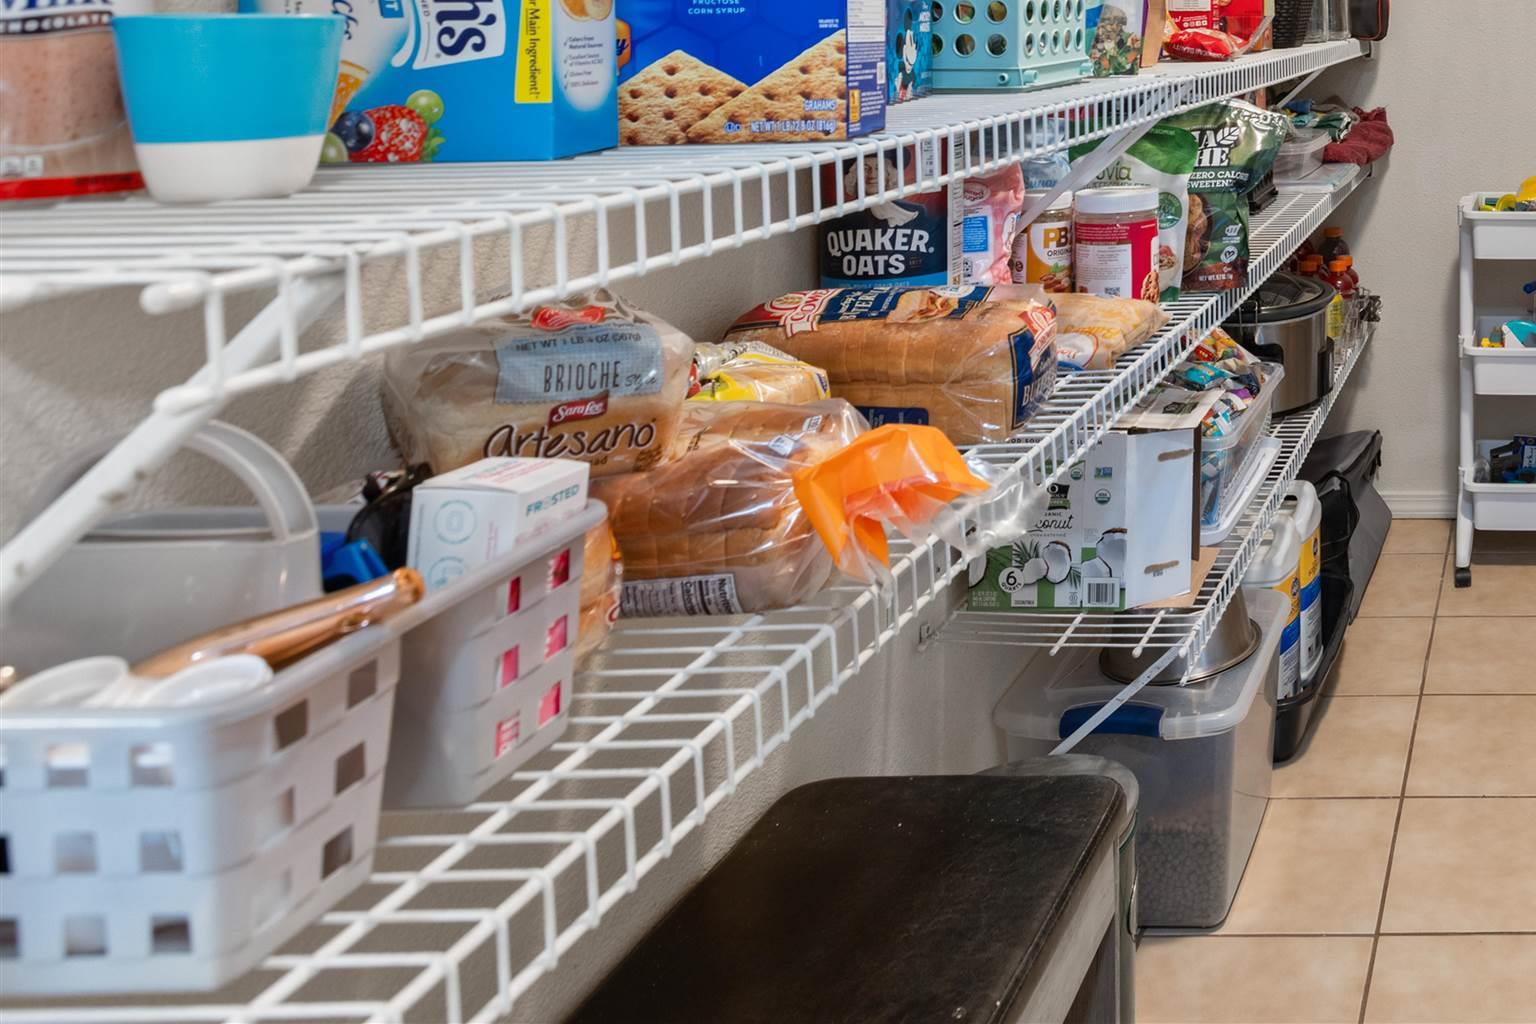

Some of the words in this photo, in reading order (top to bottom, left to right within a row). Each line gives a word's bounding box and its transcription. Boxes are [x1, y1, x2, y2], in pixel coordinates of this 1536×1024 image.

[528, 8, 541, 36] Main
[526, 38, 542, 96] Ingredient!
[804, 100, 836, 111] GRAHAMS
[1190, 171, 1215, 179] ZERO
[827, 228, 930, 257] QUAKER
[1043, 226, 1068, 249] PB
[842, 254, 905, 276] OATS
[516, 342, 537, 352] NET
[541, 339, 558, 349] WT
[570, 337, 585, 345] LB
[595, 334, 610, 344] OZ
[544, 360, 621, 393] BRIOCHE
[552, 405, 584, 422] Sara
[584, 401, 604, 417] Lee
[483, 422, 657, 459] Artesano
[1006, 571, 1017, 586] 6
